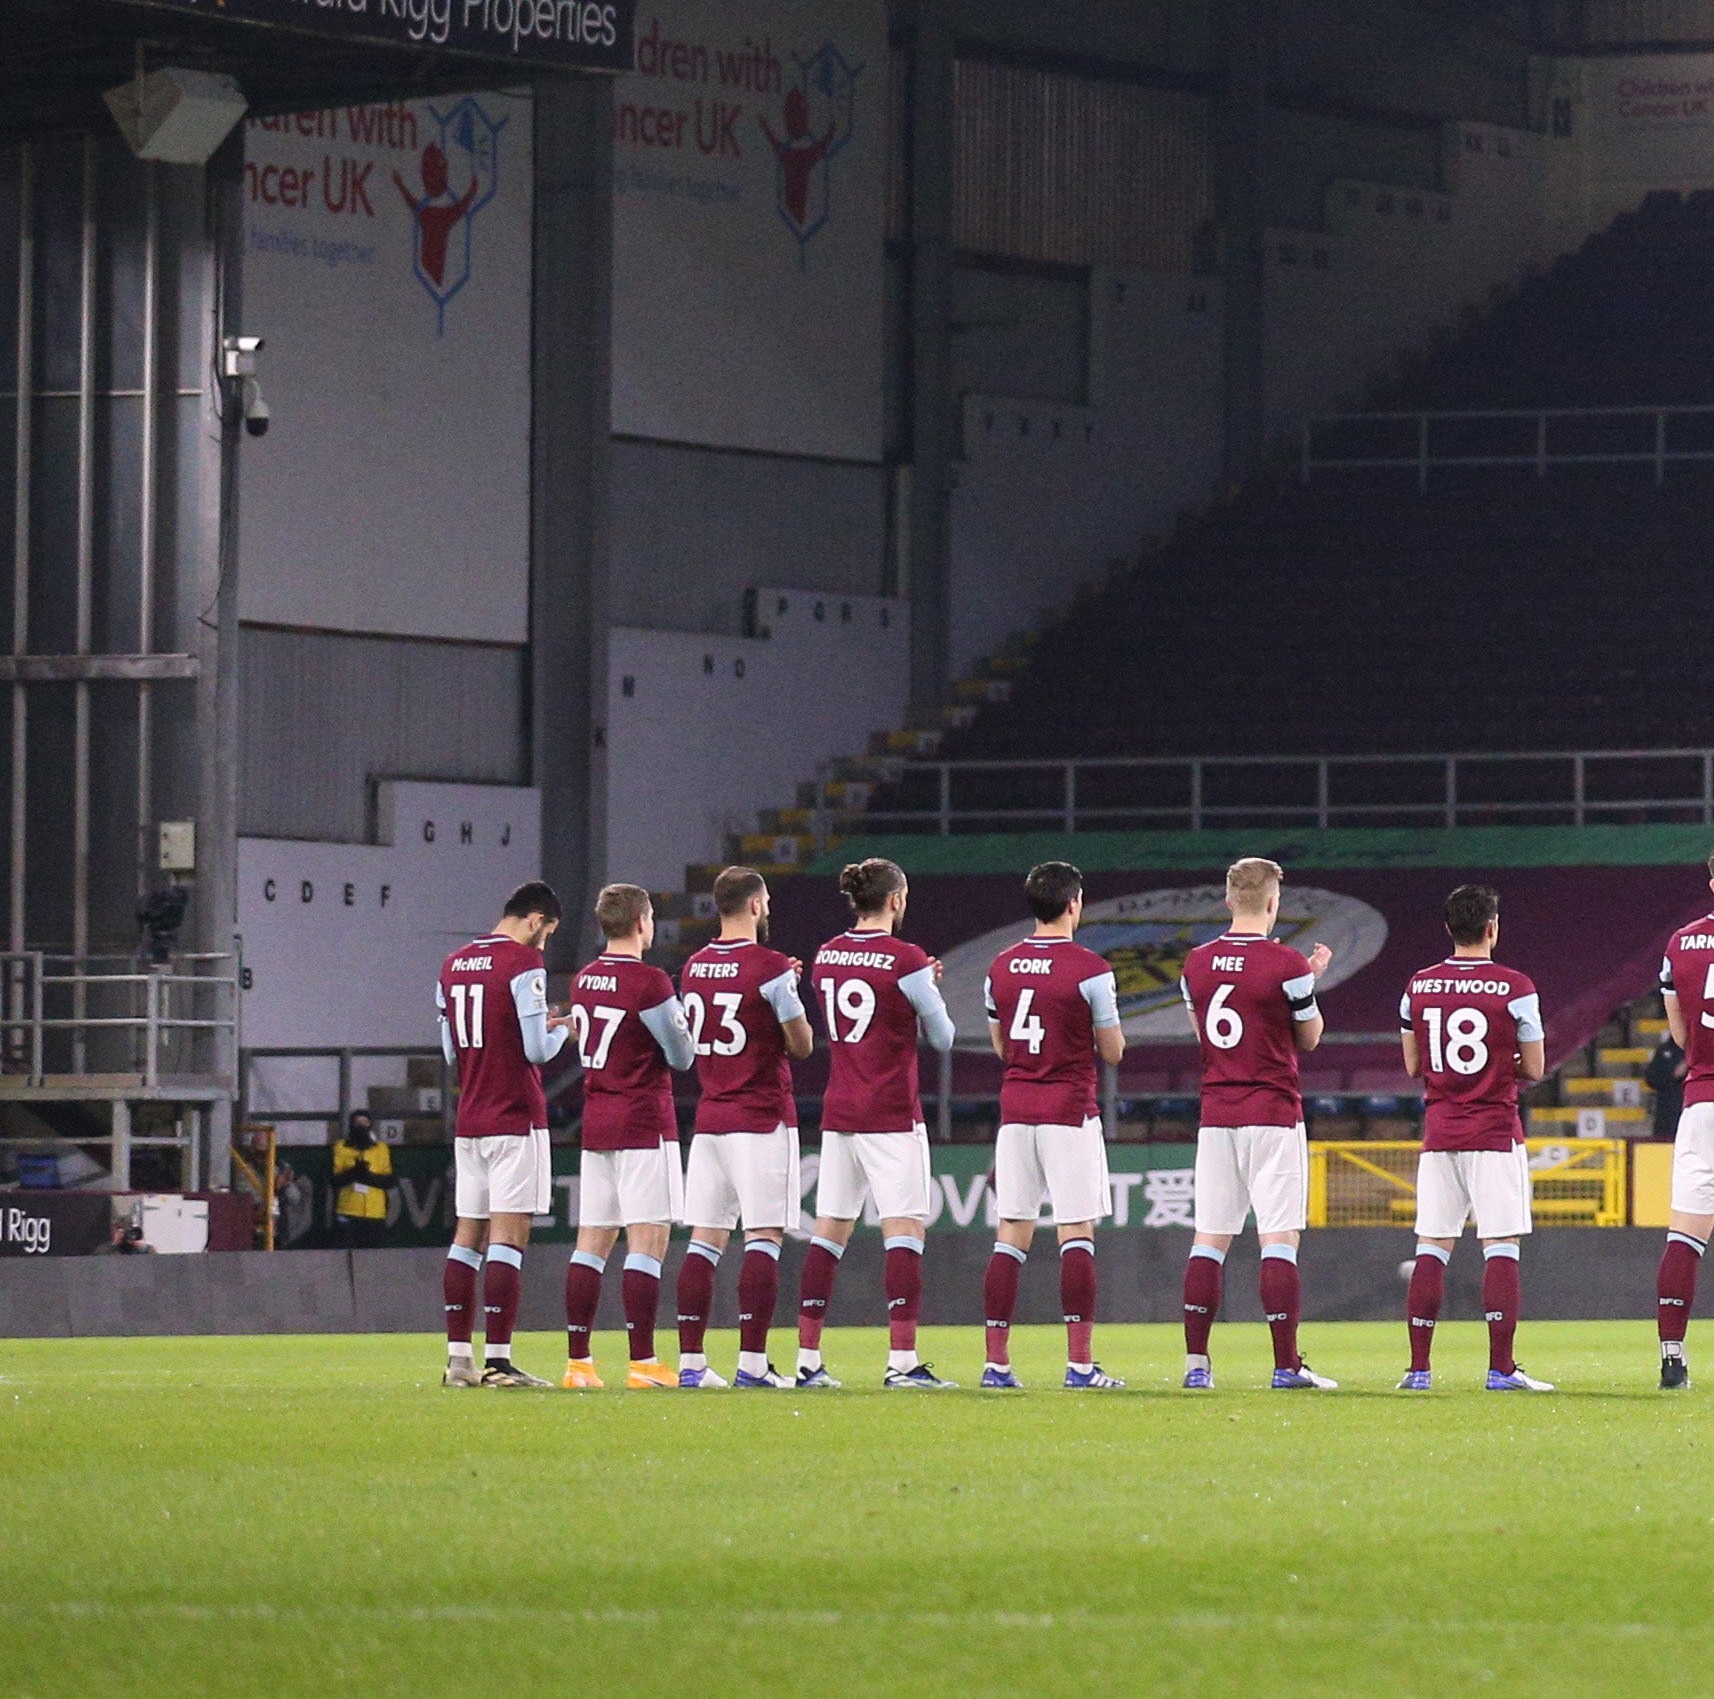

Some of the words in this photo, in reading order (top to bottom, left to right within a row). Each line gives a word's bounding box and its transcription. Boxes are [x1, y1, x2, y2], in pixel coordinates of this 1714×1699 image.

[695, 100, 743, 158] UK
[324, 154, 374, 217] UK
[423, 821, 436, 843] G
[461, 822, 473, 845] H
[500, 822, 511, 846] J
[264, 879, 276, 903] C
[301, 880, 313, 904] D
[344, 882, 355, 906] E
[380, 884, 391, 909] F
[451, 953, 494, 973] McNEIL
[688, 961, 739, 979] PIETERS
[815, 948, 896, 971] RODRIGUEZ
[1009, 957, 1052, 975] CORK
[1211, 954, 1245, 973] MEE
[578, 973, 618, 994] VYDRA
[1411, 977, 1511, 997] WESTWOOD
[450, 983, 485, 1048] 11
[685, 991, 748, 1058] 23
[820, 977, 877, 1044] 19
[1009, 988, 1046, 1055] 4
[1205, 983, 1244, 1050] 6
[573, 1004, 627, 1071] 27
[1422, 1006, 1490, 1076] 18
[9, 1208, 51, 1254] Rigg
